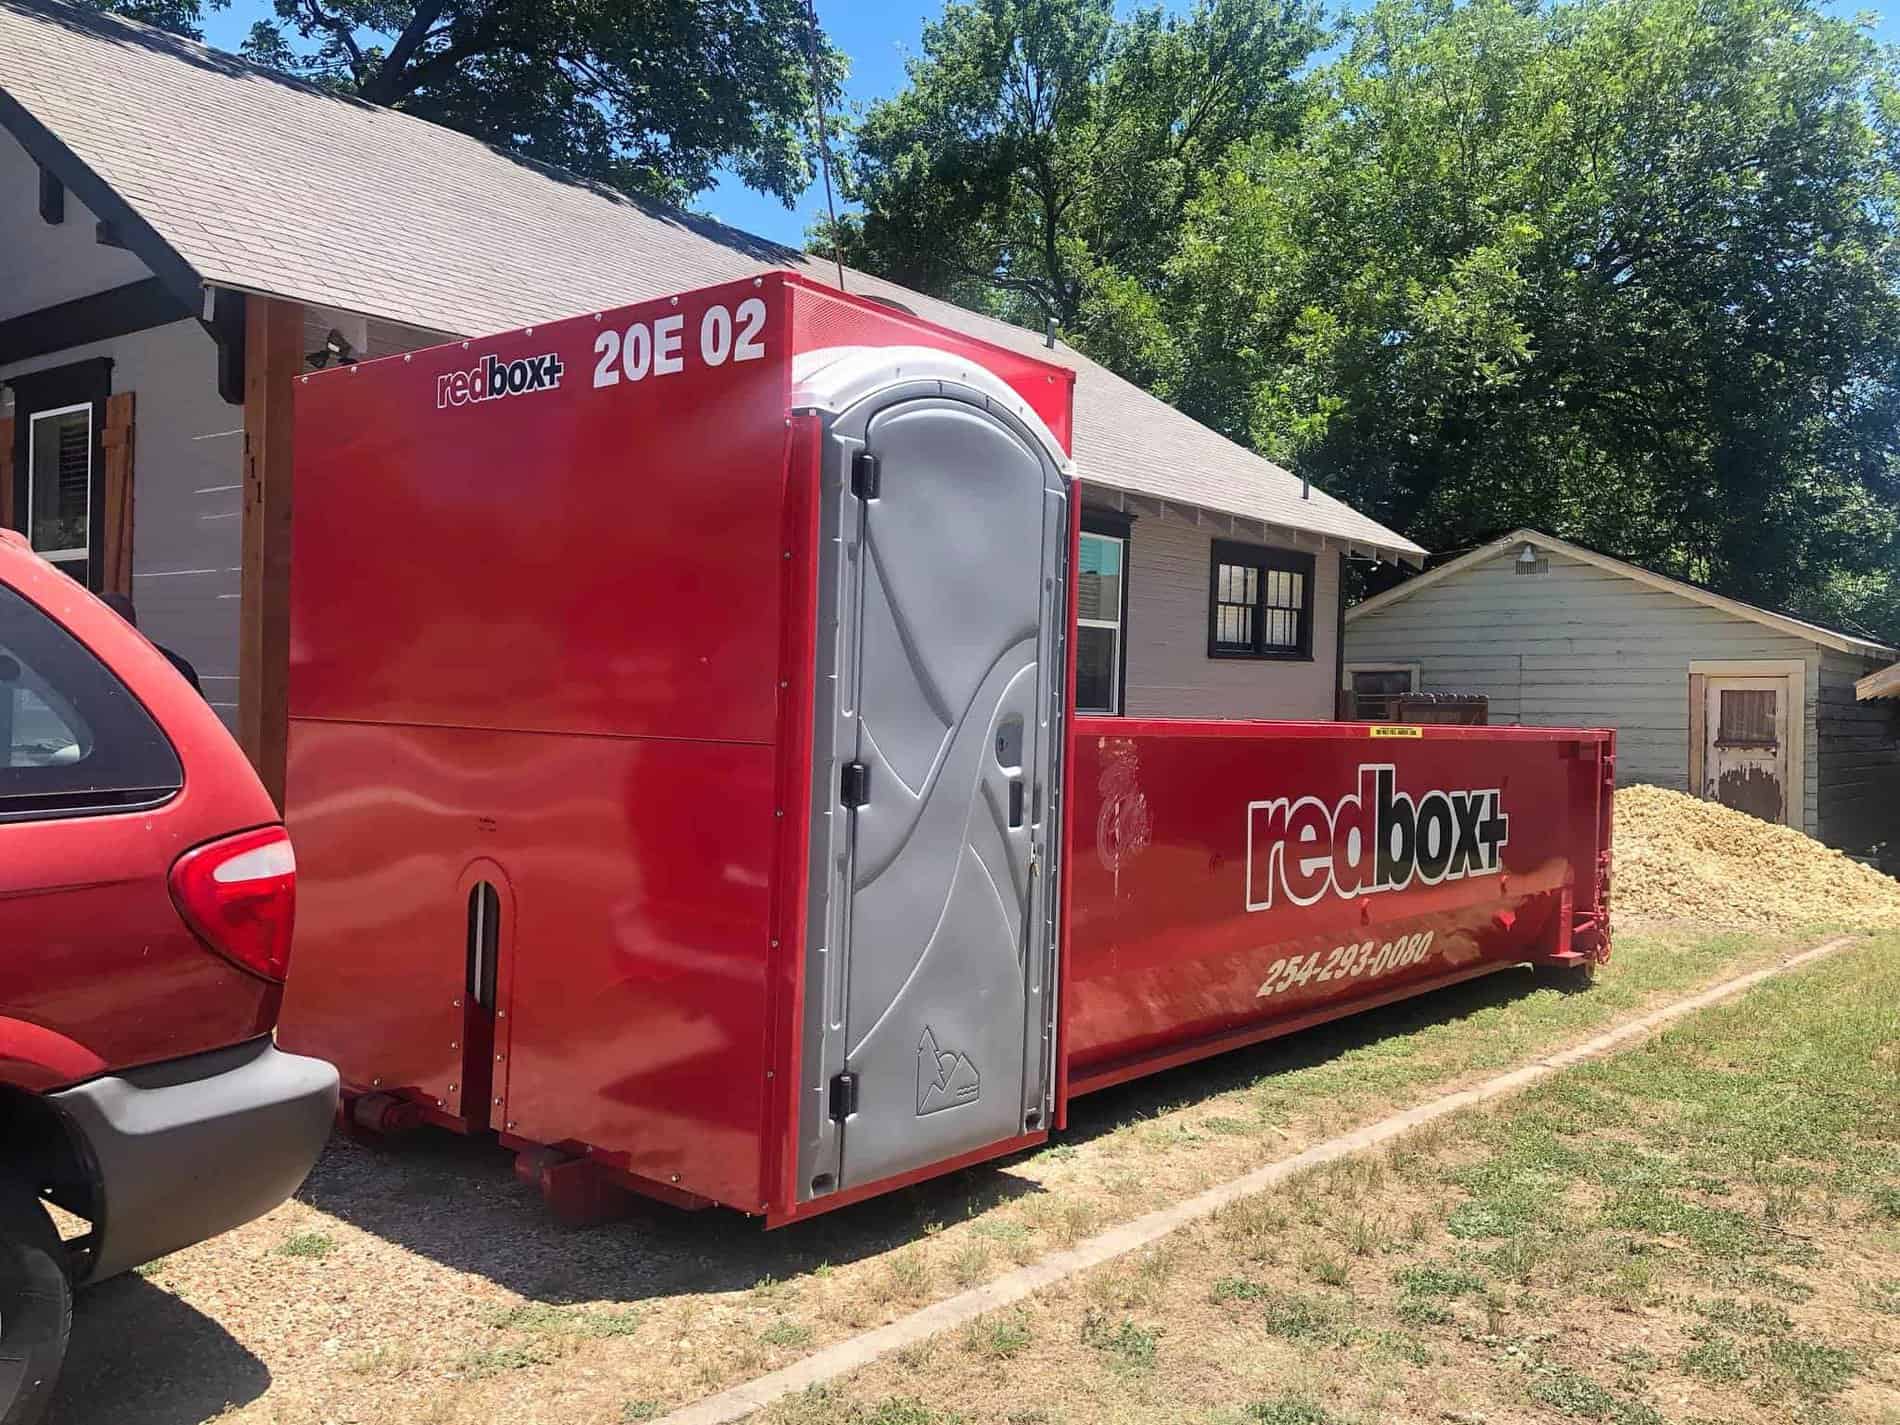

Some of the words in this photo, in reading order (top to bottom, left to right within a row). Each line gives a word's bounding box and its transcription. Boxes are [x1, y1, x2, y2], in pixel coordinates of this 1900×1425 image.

[437, 354, 563, 408] redbox+
[593, 314, 684, 389] 20E
[700, 298, 766, 367] 02
[1246, 763, 1508, 912] redbox+
[1256, 930, 1434, 998] 254-293-0080
